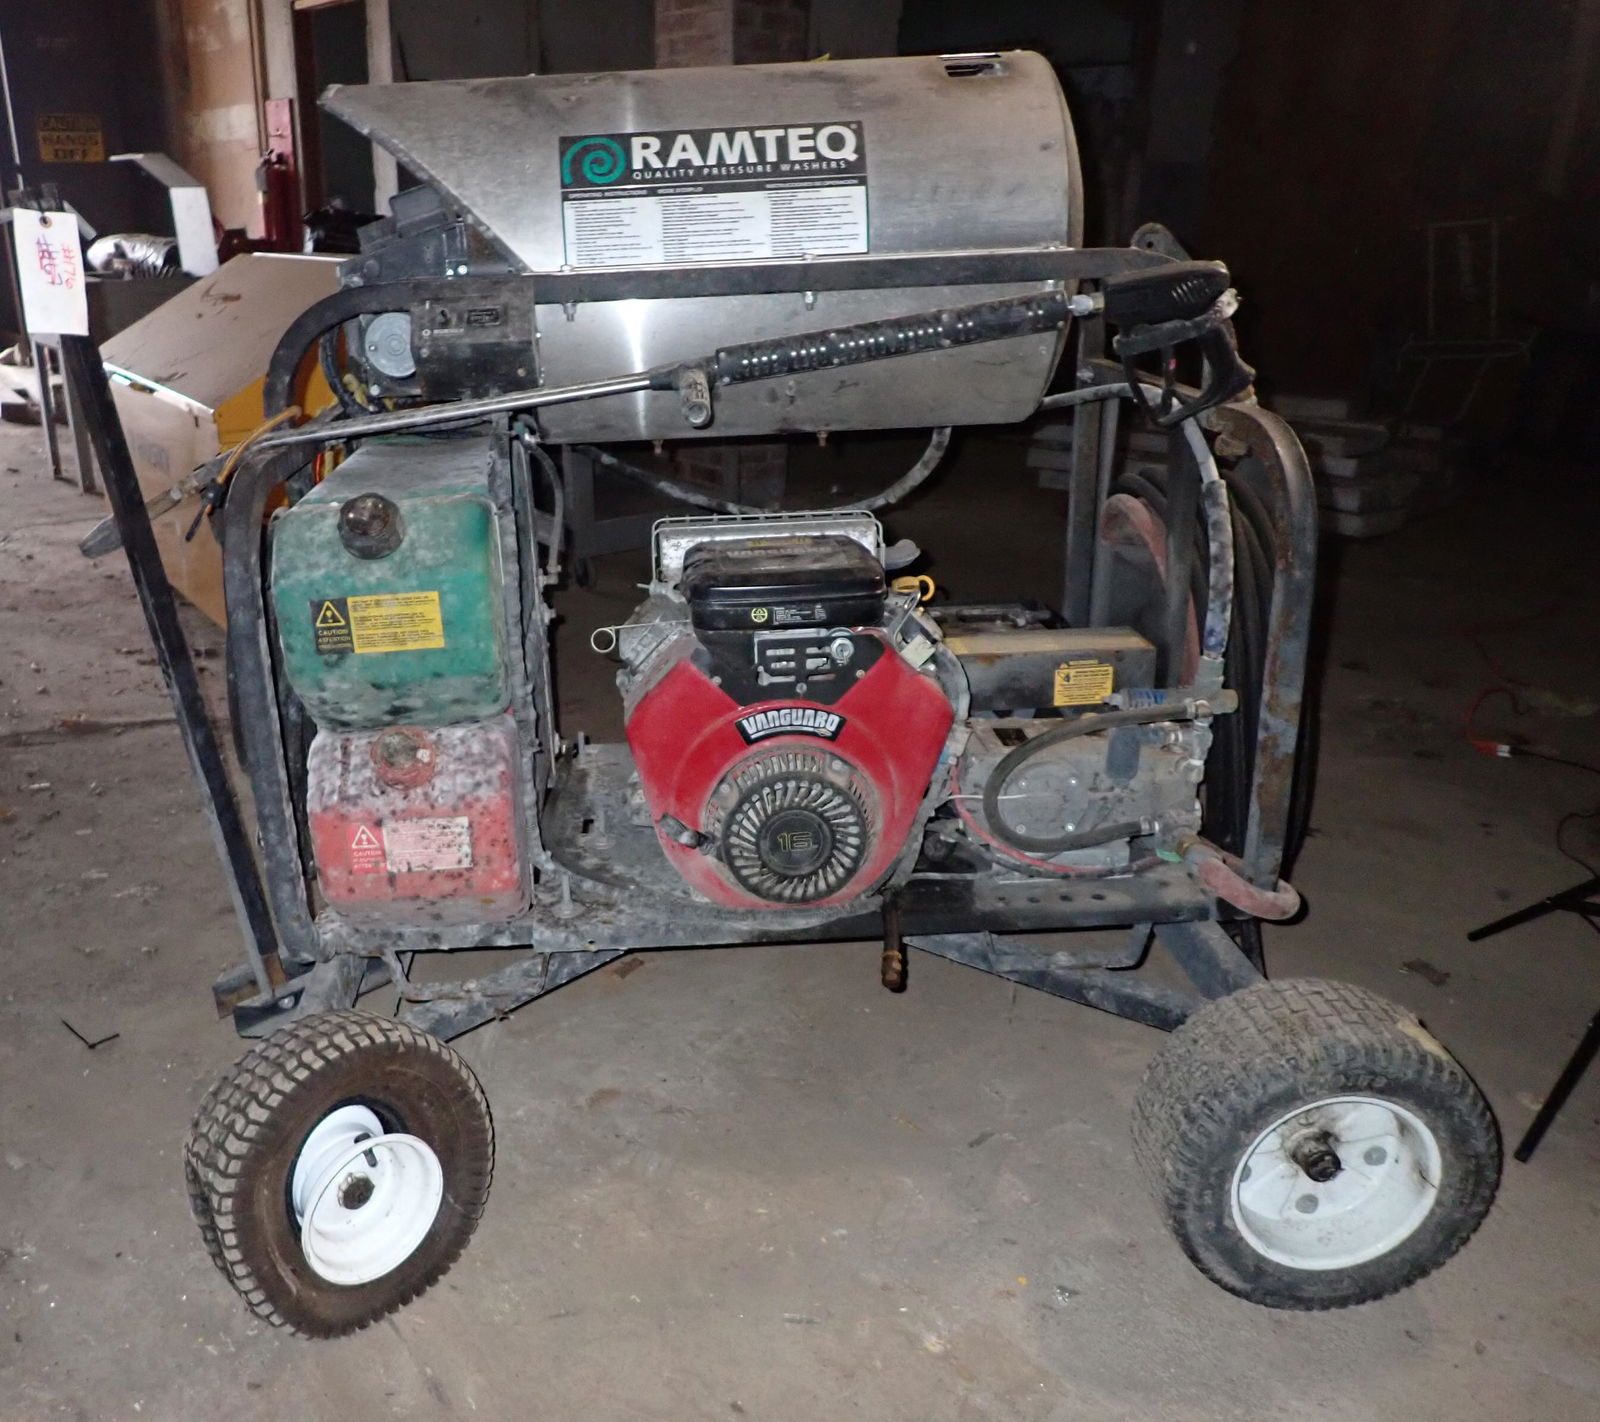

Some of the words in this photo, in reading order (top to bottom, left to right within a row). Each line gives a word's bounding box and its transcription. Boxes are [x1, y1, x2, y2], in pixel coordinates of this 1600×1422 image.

[630, 125, 859, 170] RAMTEQ
[632, 169, 695, 180] QUALITY
[703, 164, 772, 176] PRESSURE
[780, 160, 847, 172] WASHERS
[741, 708, 841, 735] VANGUARD
